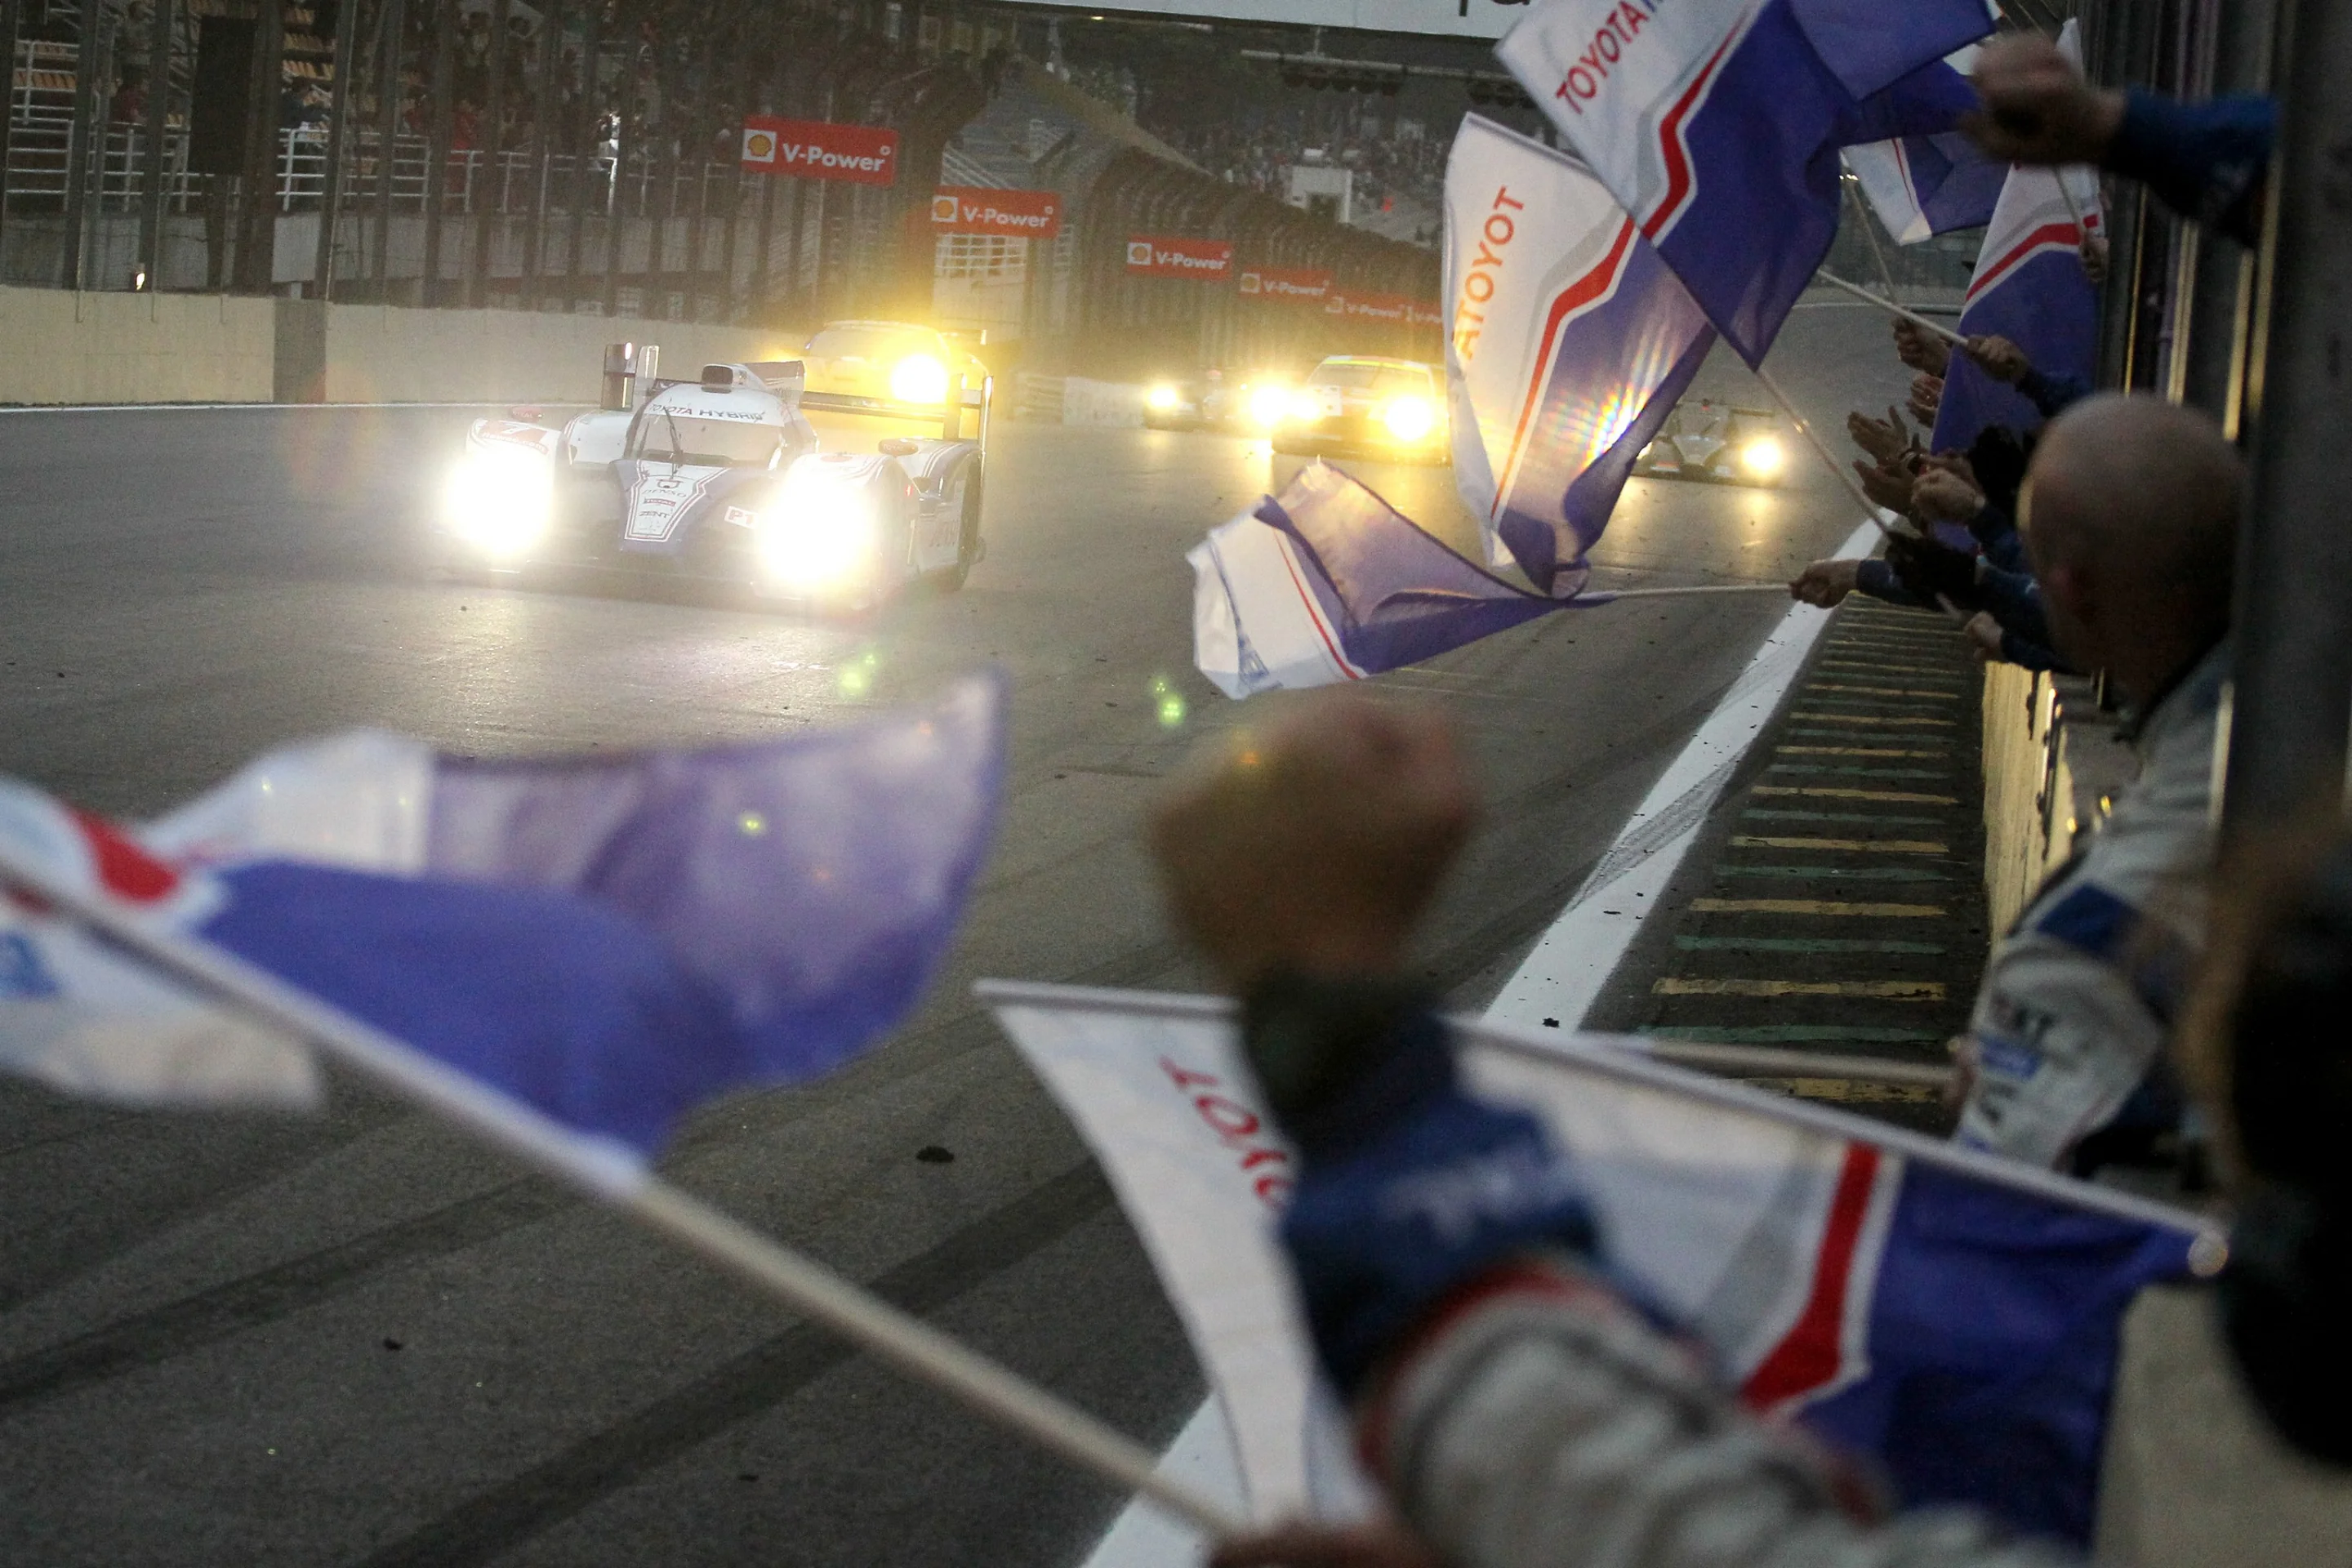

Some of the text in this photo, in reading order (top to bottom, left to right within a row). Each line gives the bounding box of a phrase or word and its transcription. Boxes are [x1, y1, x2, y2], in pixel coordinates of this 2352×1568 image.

[1556, 0, 1650, 115] TOYOTA
[783, 145, 885, 172] V-Power
[963, 206, 1049, 229] V-Power
[1156, 252, 1225, 270] V-Power
[1263, 280, 1326, 296] V-Power
[650, 403, 764, 421] TOYOTA HYBRID
[639, 510, 670, 519] ZENT
